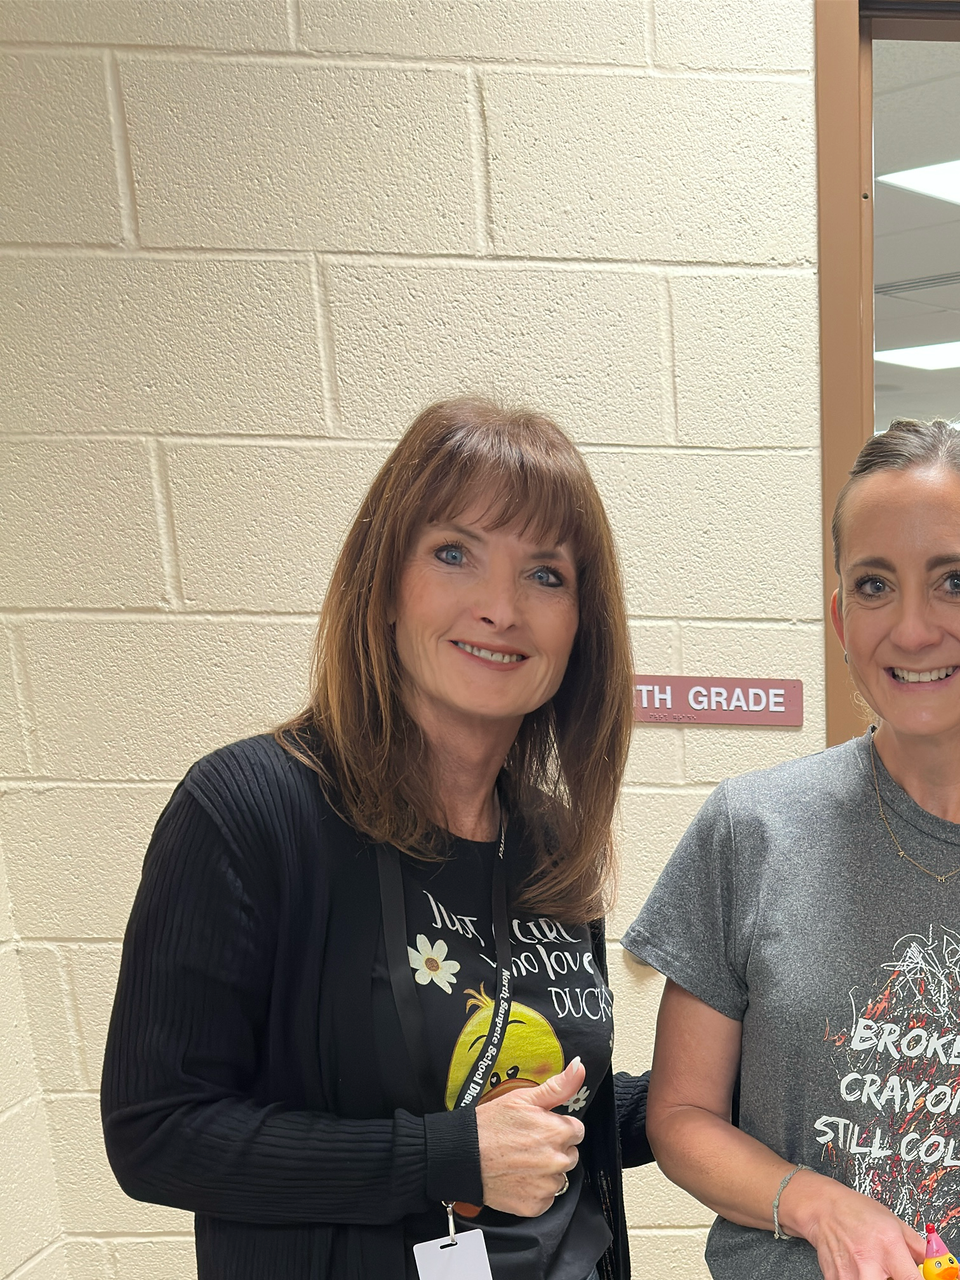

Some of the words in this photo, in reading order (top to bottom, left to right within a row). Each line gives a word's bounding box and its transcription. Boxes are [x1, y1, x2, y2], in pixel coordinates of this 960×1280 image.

[688, 686, 786, 712] GRADE
[512, 917, 582, 944] GIRL
[500, 968, 511, 999] North
[547, 985, 612, 1022] DUCK
[491, 1001, 508, 1044] Sanpete
[473, 1045, 497, 1084] School
[460, 1083, 481, 1107] Dist
[814, 1116, 893, 1158] STILL
